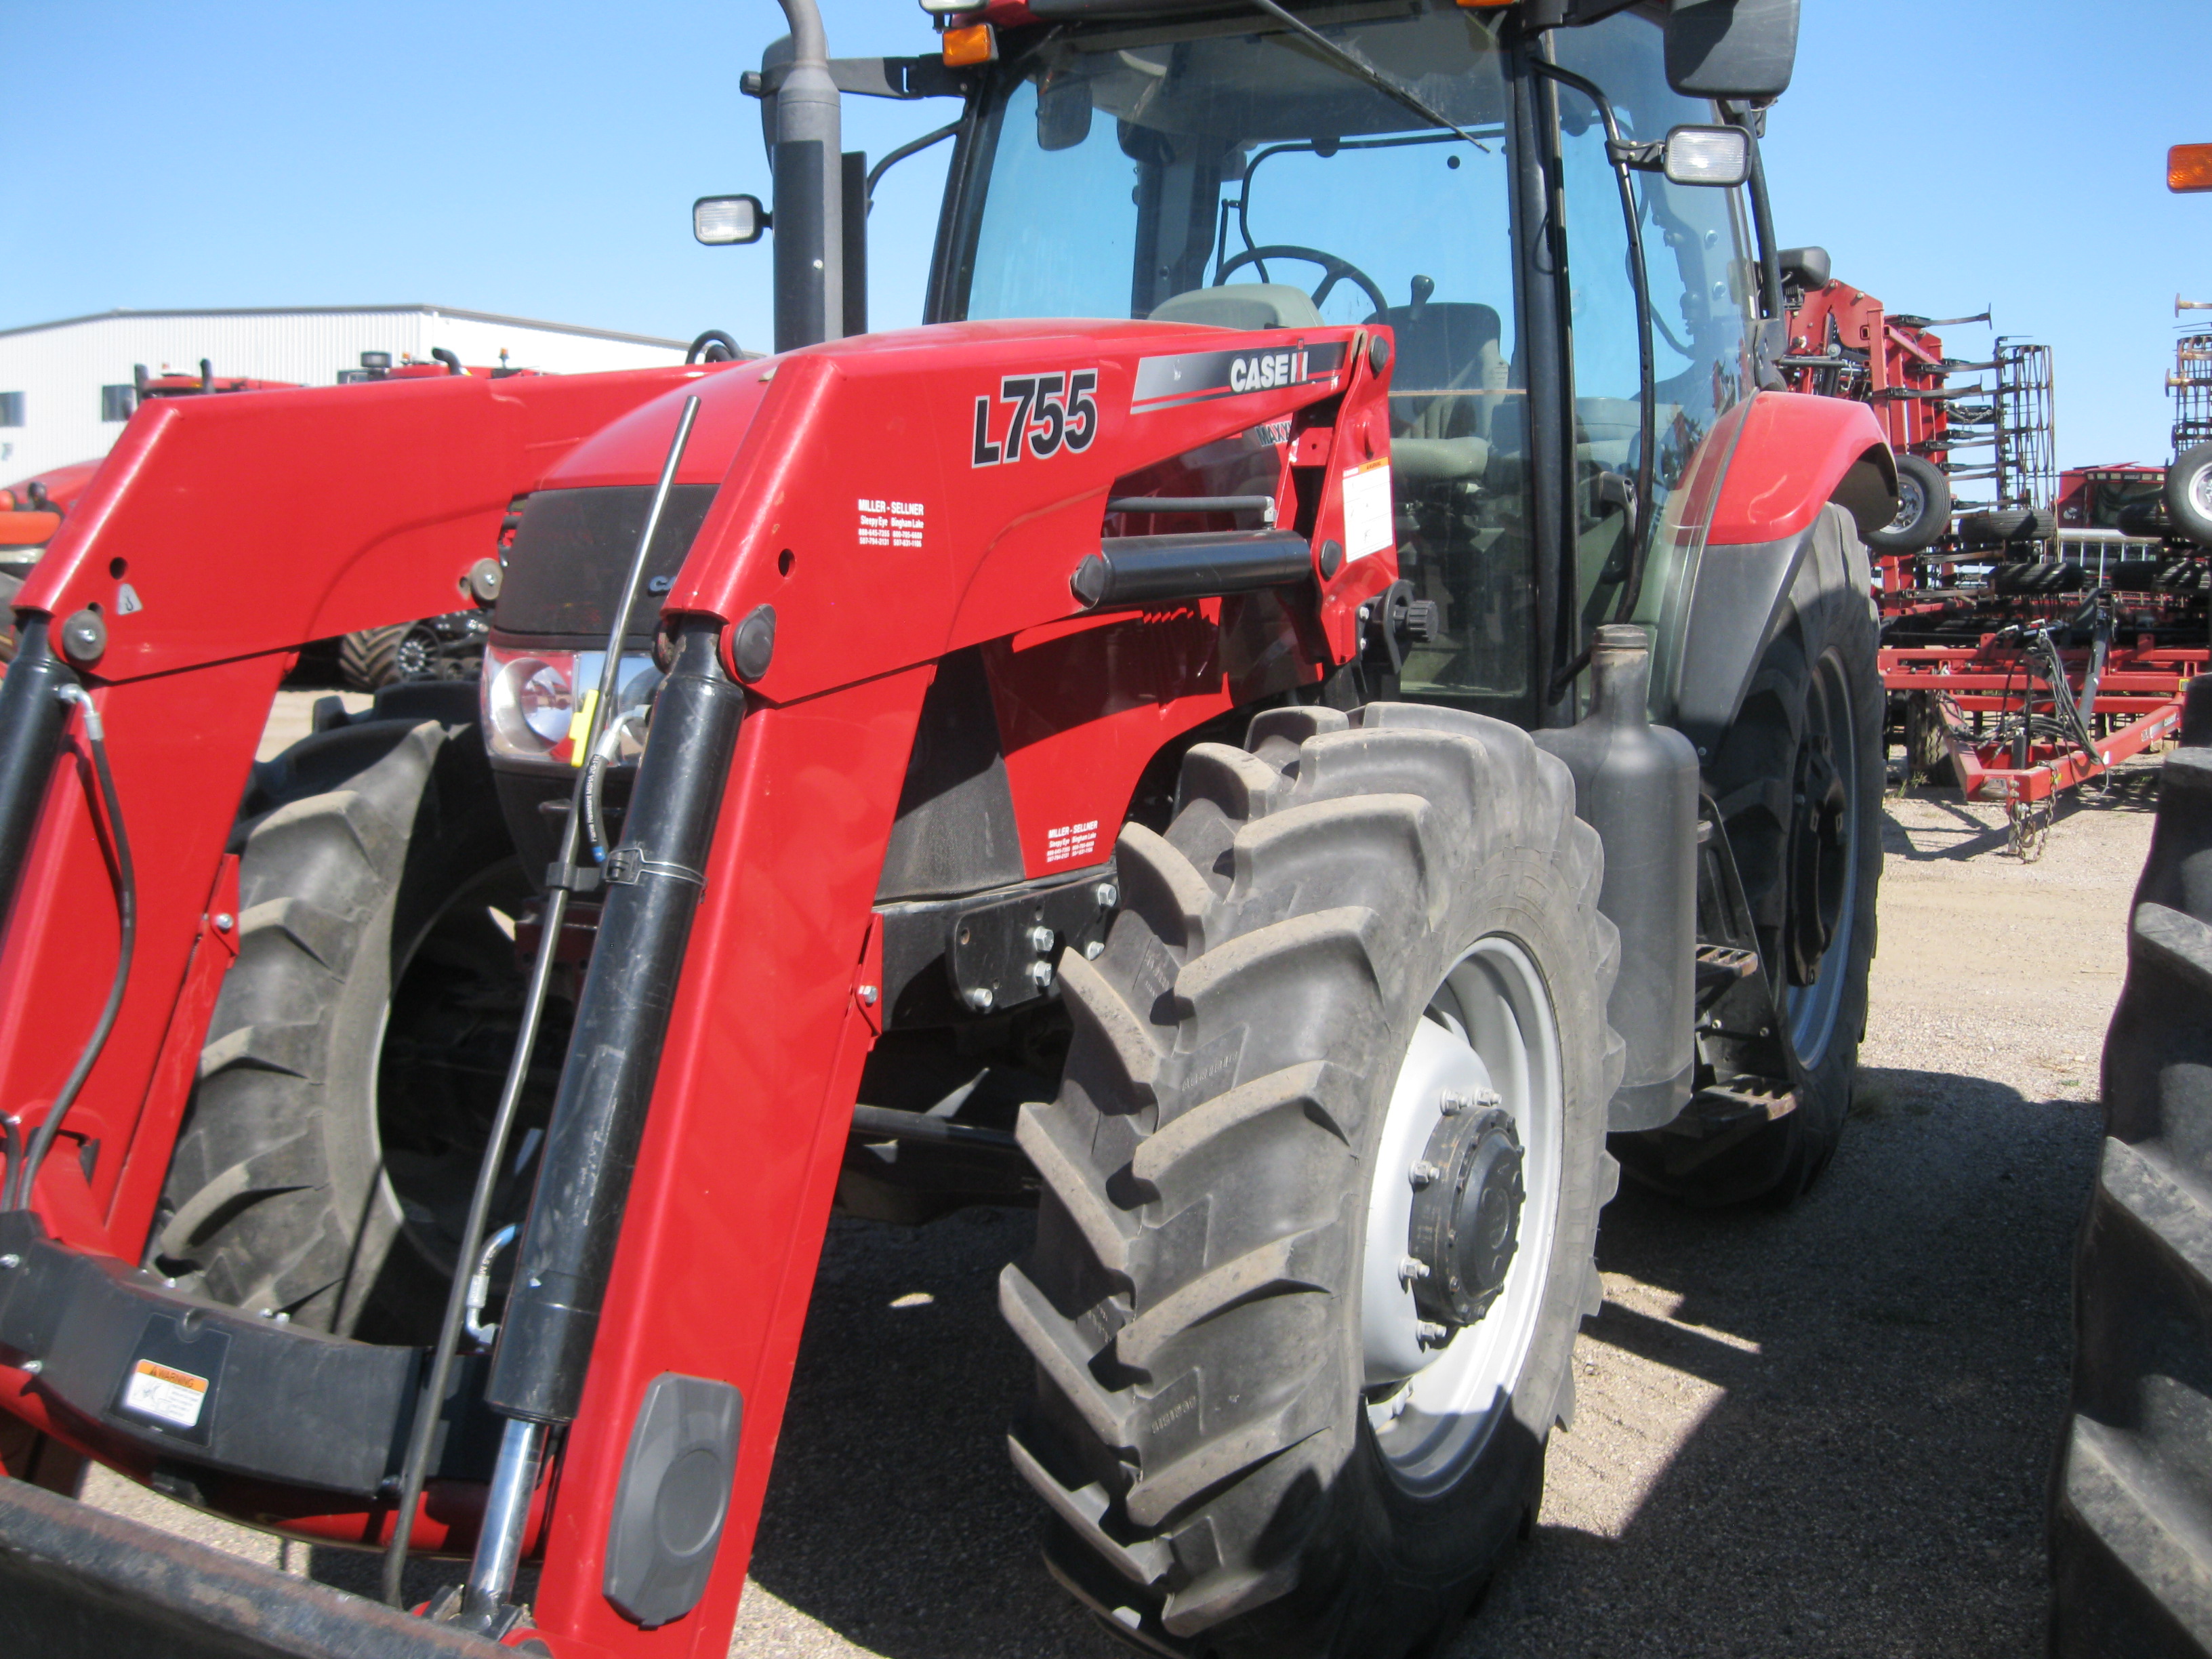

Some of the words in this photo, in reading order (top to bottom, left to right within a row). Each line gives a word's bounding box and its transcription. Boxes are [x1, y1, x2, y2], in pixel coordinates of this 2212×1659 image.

[1230, 354, 1289, 392] CASE
[972, 368, 1098, 469] L755
[1255, 420, 1292, 447] MAXX
[858, 499, 886, 513] MILLER
[890, 501, 924, 516] SELLNER
[860, 515, 878, 528] Sleepy
[878, 516, 888, 528] Eye
[890, 517, 912, 529] Bingham
[912, 519, 924, 529] Lake
[1048, 826, 1070, 839] MILLER
[1073, 820, 1098, 834] SELLNER
[159, 1366, 194, 1388] WARNING
